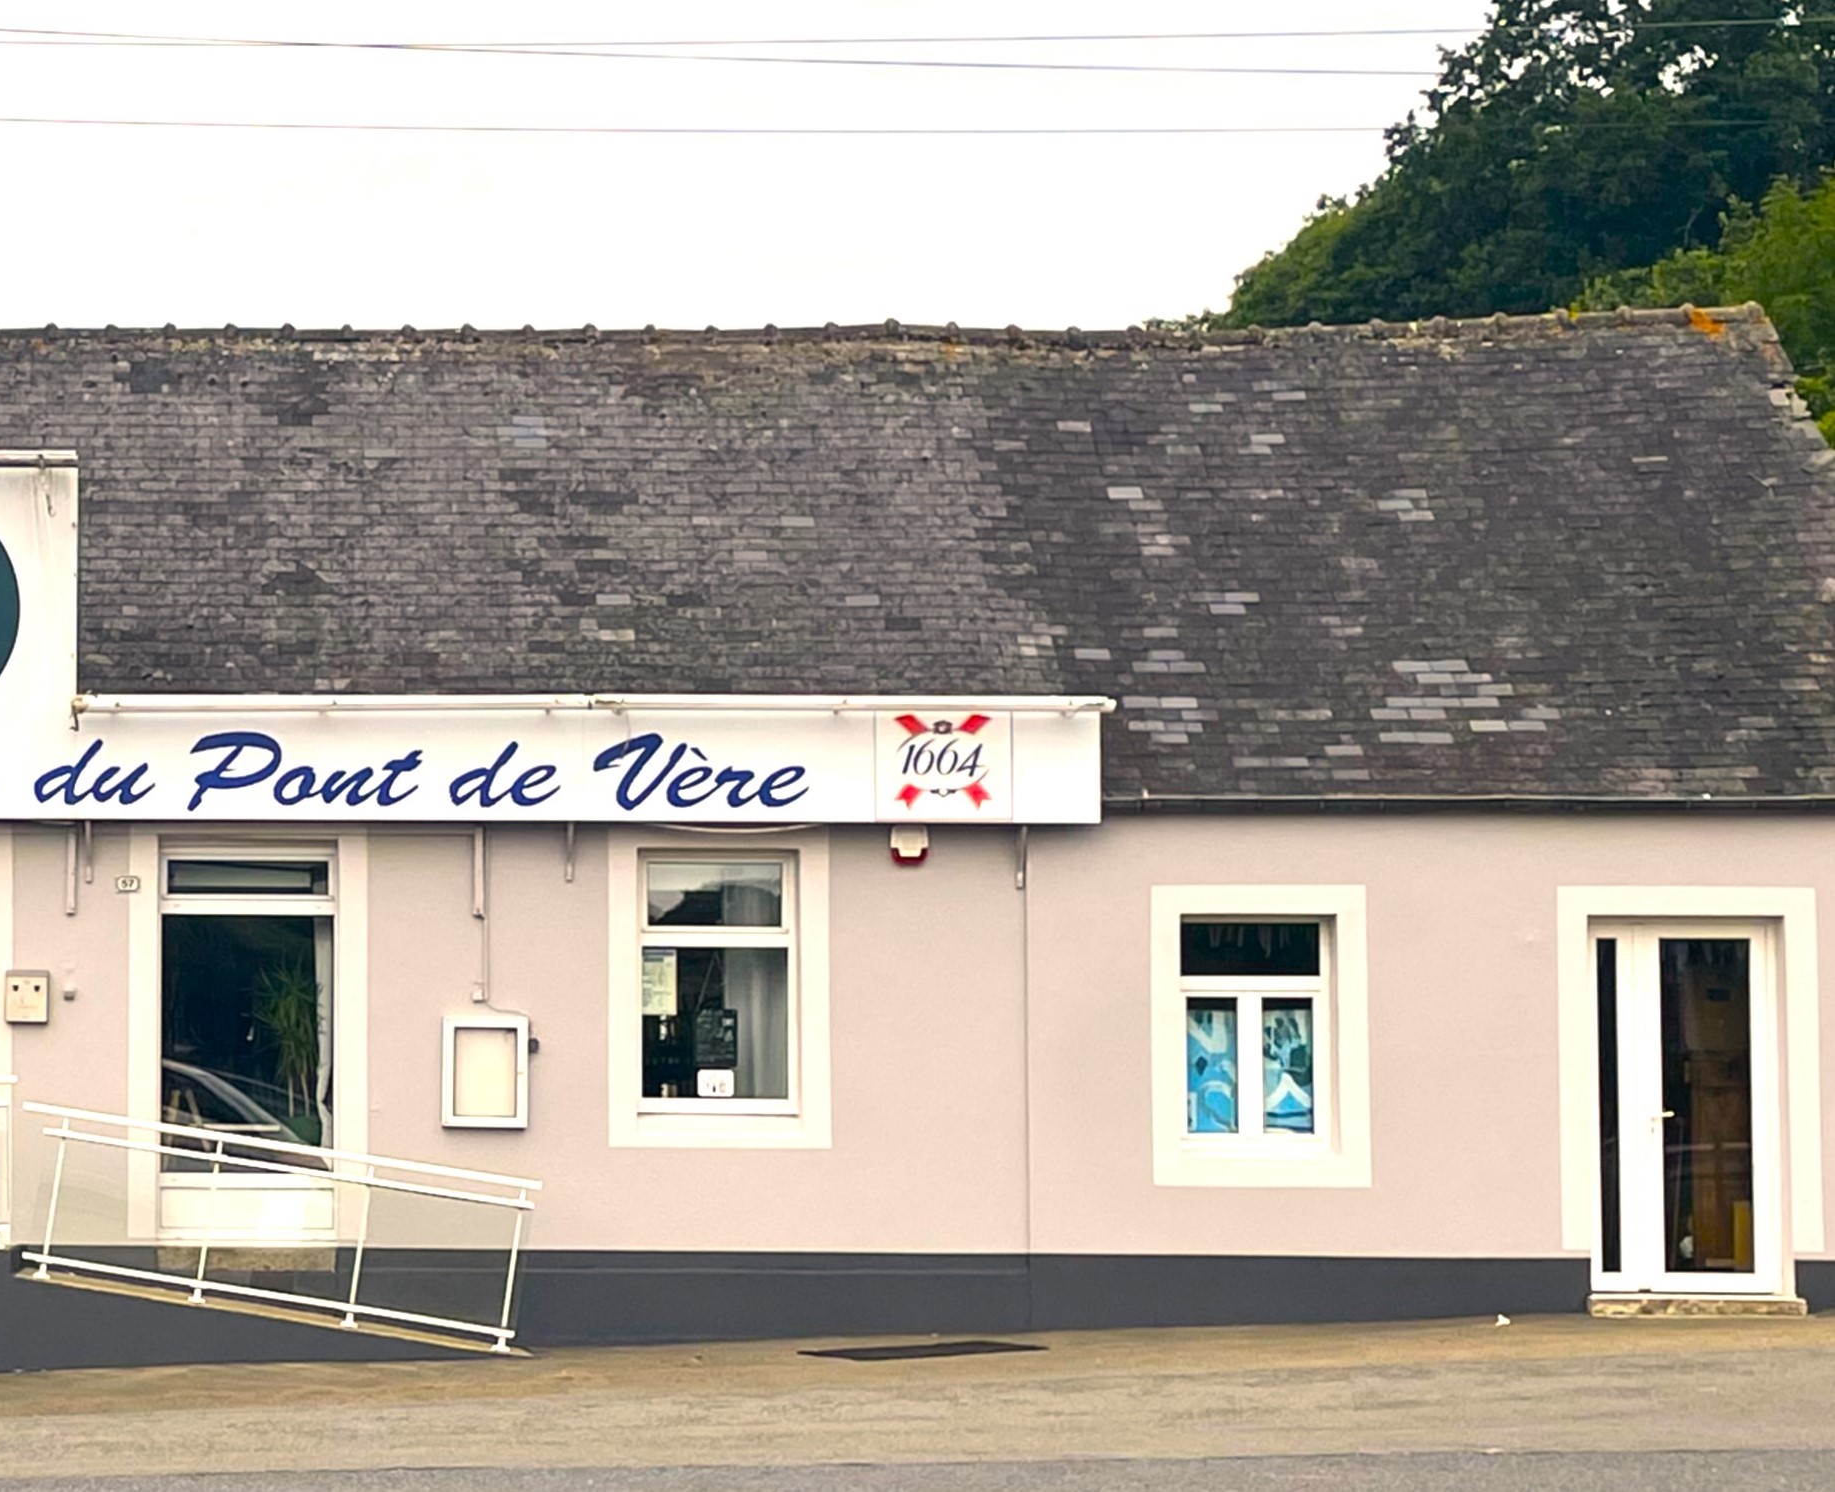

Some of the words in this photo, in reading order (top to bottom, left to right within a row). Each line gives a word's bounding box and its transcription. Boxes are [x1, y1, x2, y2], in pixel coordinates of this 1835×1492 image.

[33, 740, 153, 806] du
[188, 731, 422, 811] Pont
[449, 742, 561, 808] de
[593, 732, 810, 812] Vère
[901, 737, 987, 778] 1664
